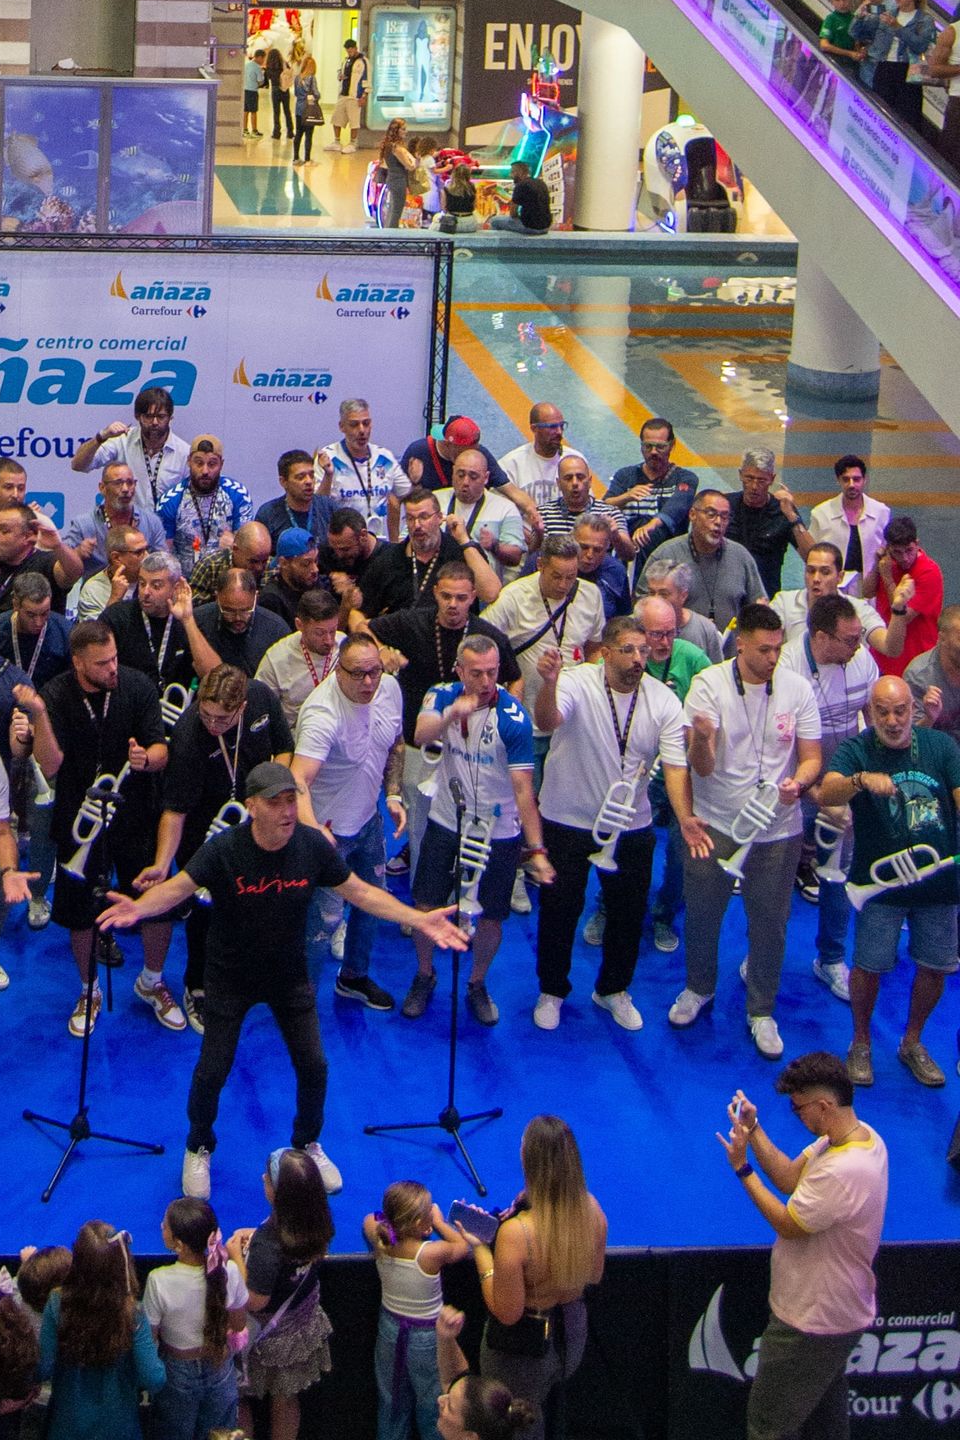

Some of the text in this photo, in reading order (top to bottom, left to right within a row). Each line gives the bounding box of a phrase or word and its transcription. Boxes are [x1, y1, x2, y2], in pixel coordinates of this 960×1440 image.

[484, 23, 582, 71] ENJO
[130, 281, 211, 301] añaza
[335, 283, 415, 303] añaza
[131, 306, 183, 317] Carrefour
[336, 307, 386, 318] Carrefour
[36, 336, 187, 352] centro comercial
[252, 368, 332, 388] añaza
[253, 393, 304, 403] Carrefour
[887, 1311, 955, 1327] comercial
[744, 1329, 960, 1378] aza
